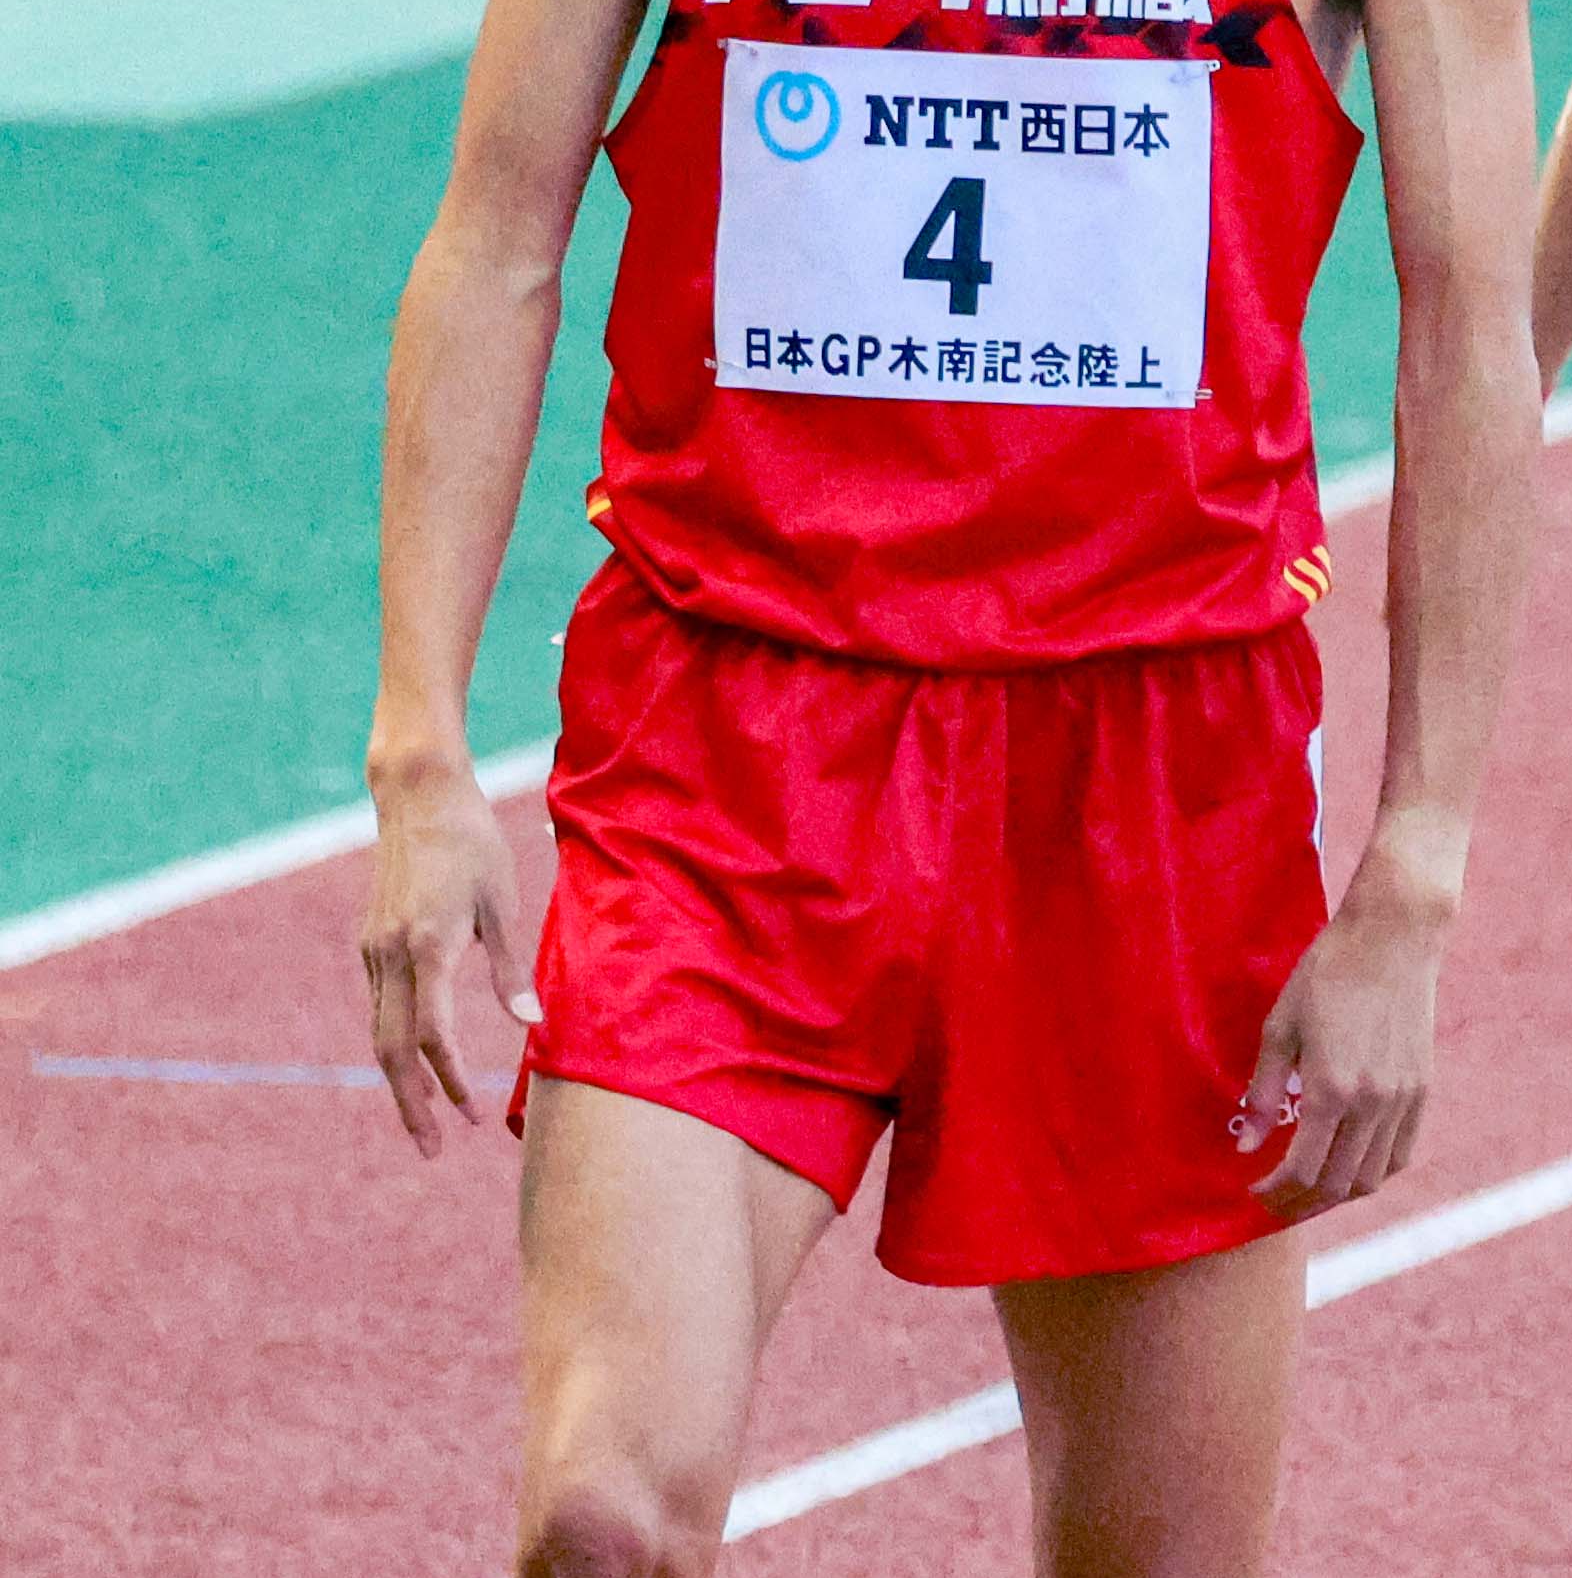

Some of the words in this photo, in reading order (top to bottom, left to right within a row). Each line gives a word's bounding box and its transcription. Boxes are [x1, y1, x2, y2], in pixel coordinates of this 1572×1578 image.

[902, 177, 993, 316] 4
[745, 327, 1164, 391] 日本GP木南記念陸上
